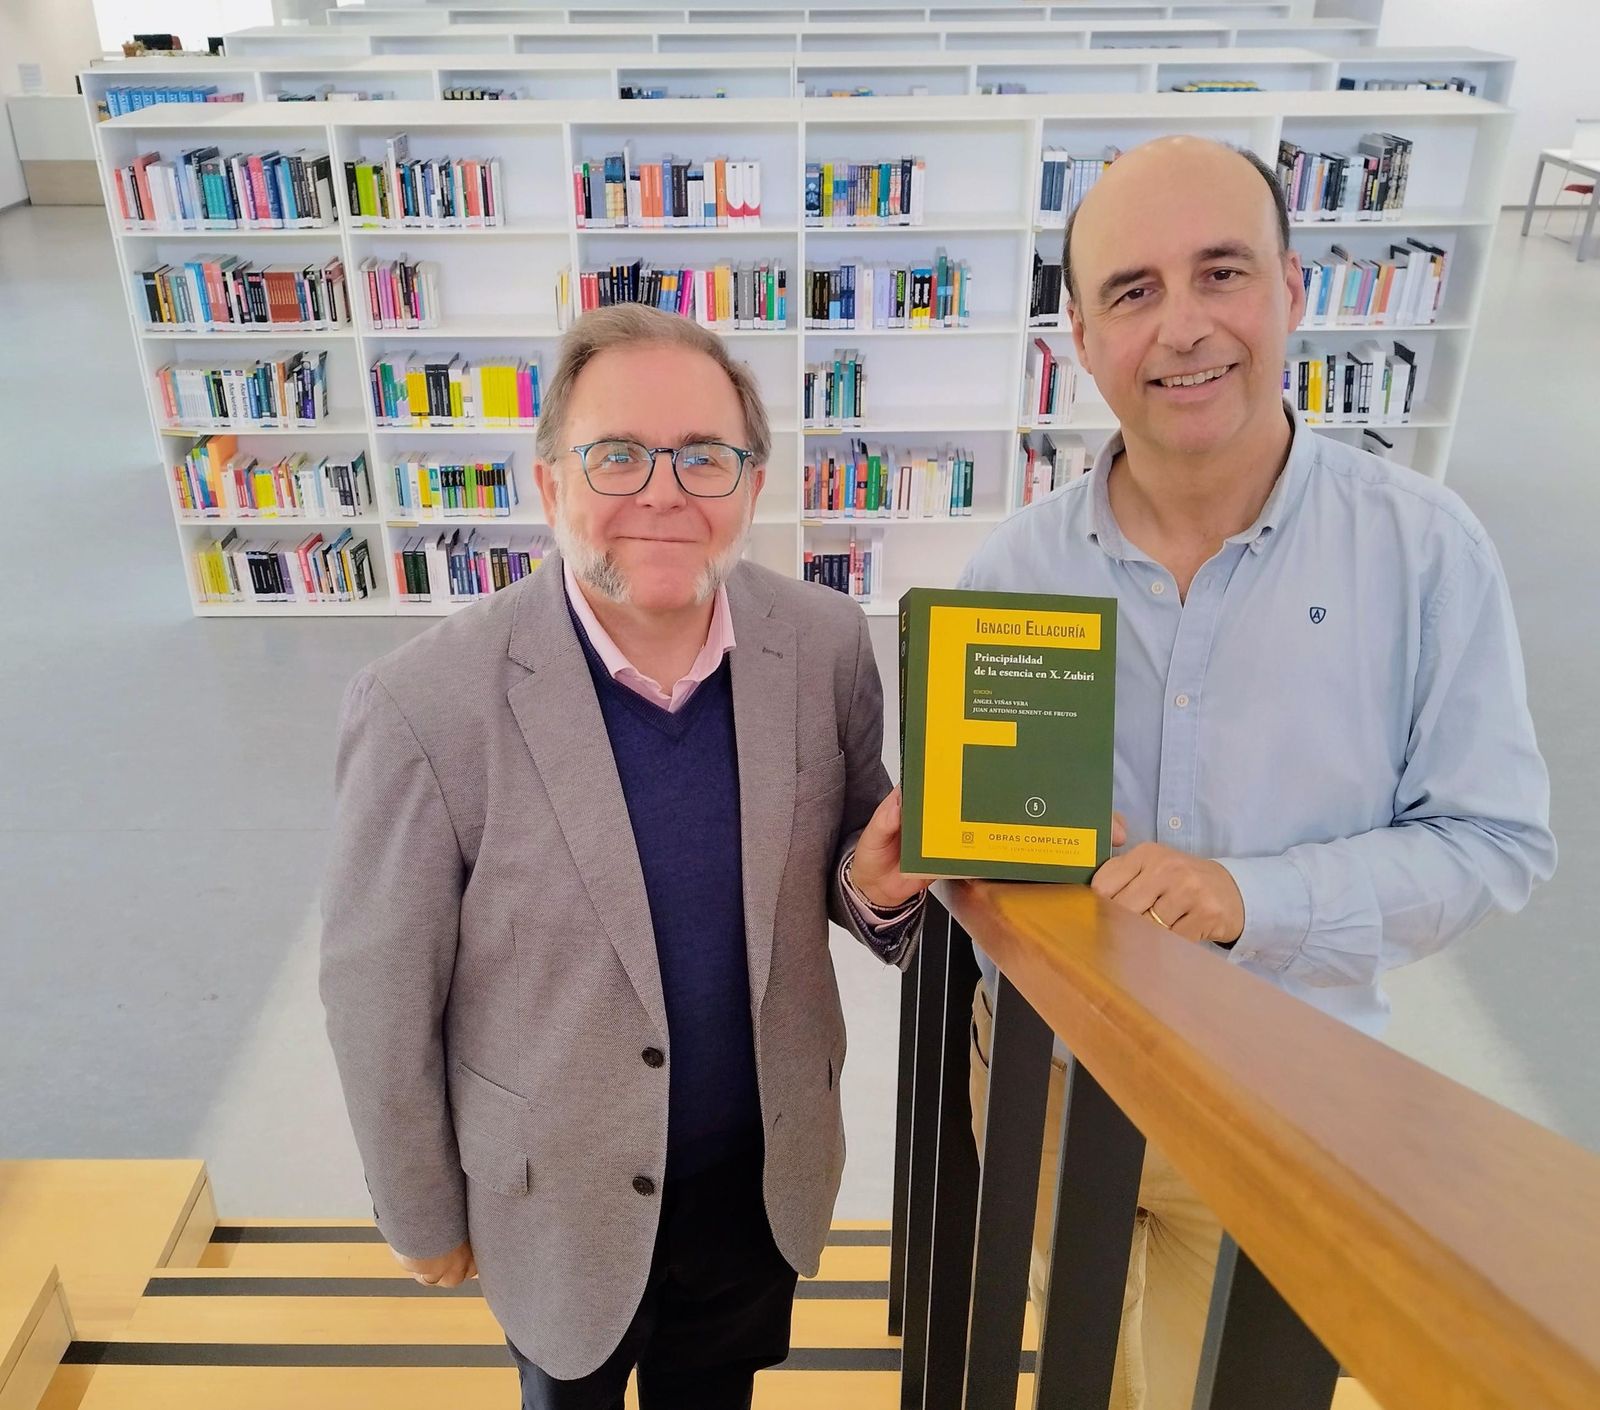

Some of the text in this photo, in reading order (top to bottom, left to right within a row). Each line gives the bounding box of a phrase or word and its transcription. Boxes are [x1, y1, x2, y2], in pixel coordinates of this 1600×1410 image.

[229, 382, 238, 418] Marketing
[240, 382, 249, 418] Marketing
[976, 618, 1086, 638] IGNACIO ELLACURÍA
[974, 652, 1043, 665] Principialidad
[974, 666, 1095, 681] de la esencia en X. Zubiri
[973, 697, 994, 705] ÁNGEL
[994, 698, 1012, 706] VIÑAS
[1053, 710, 1077, 718] FRUTOS
[988, 833, 1080, 846] OBRAS COMPLETAS
